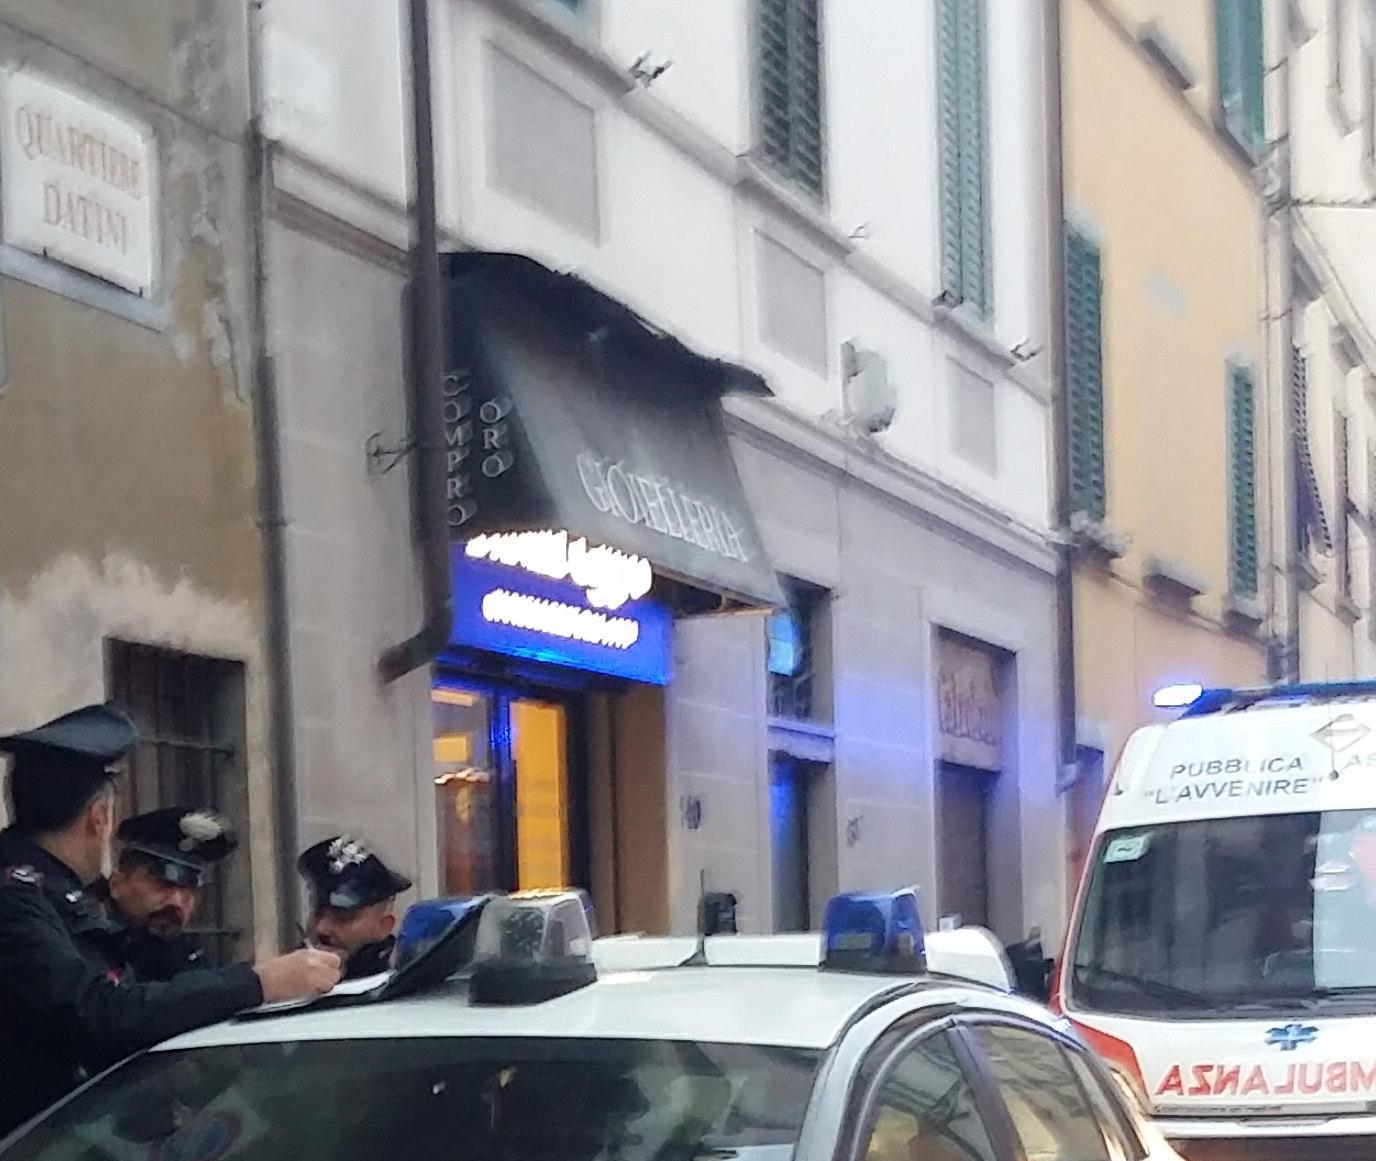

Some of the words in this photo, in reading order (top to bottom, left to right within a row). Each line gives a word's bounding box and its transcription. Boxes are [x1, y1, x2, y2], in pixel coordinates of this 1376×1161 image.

[42, 180, 128, 255] DATINI
[479, 398, 514, 478] ORO
[1169, 756, 1305, 781] PUBBLICA
